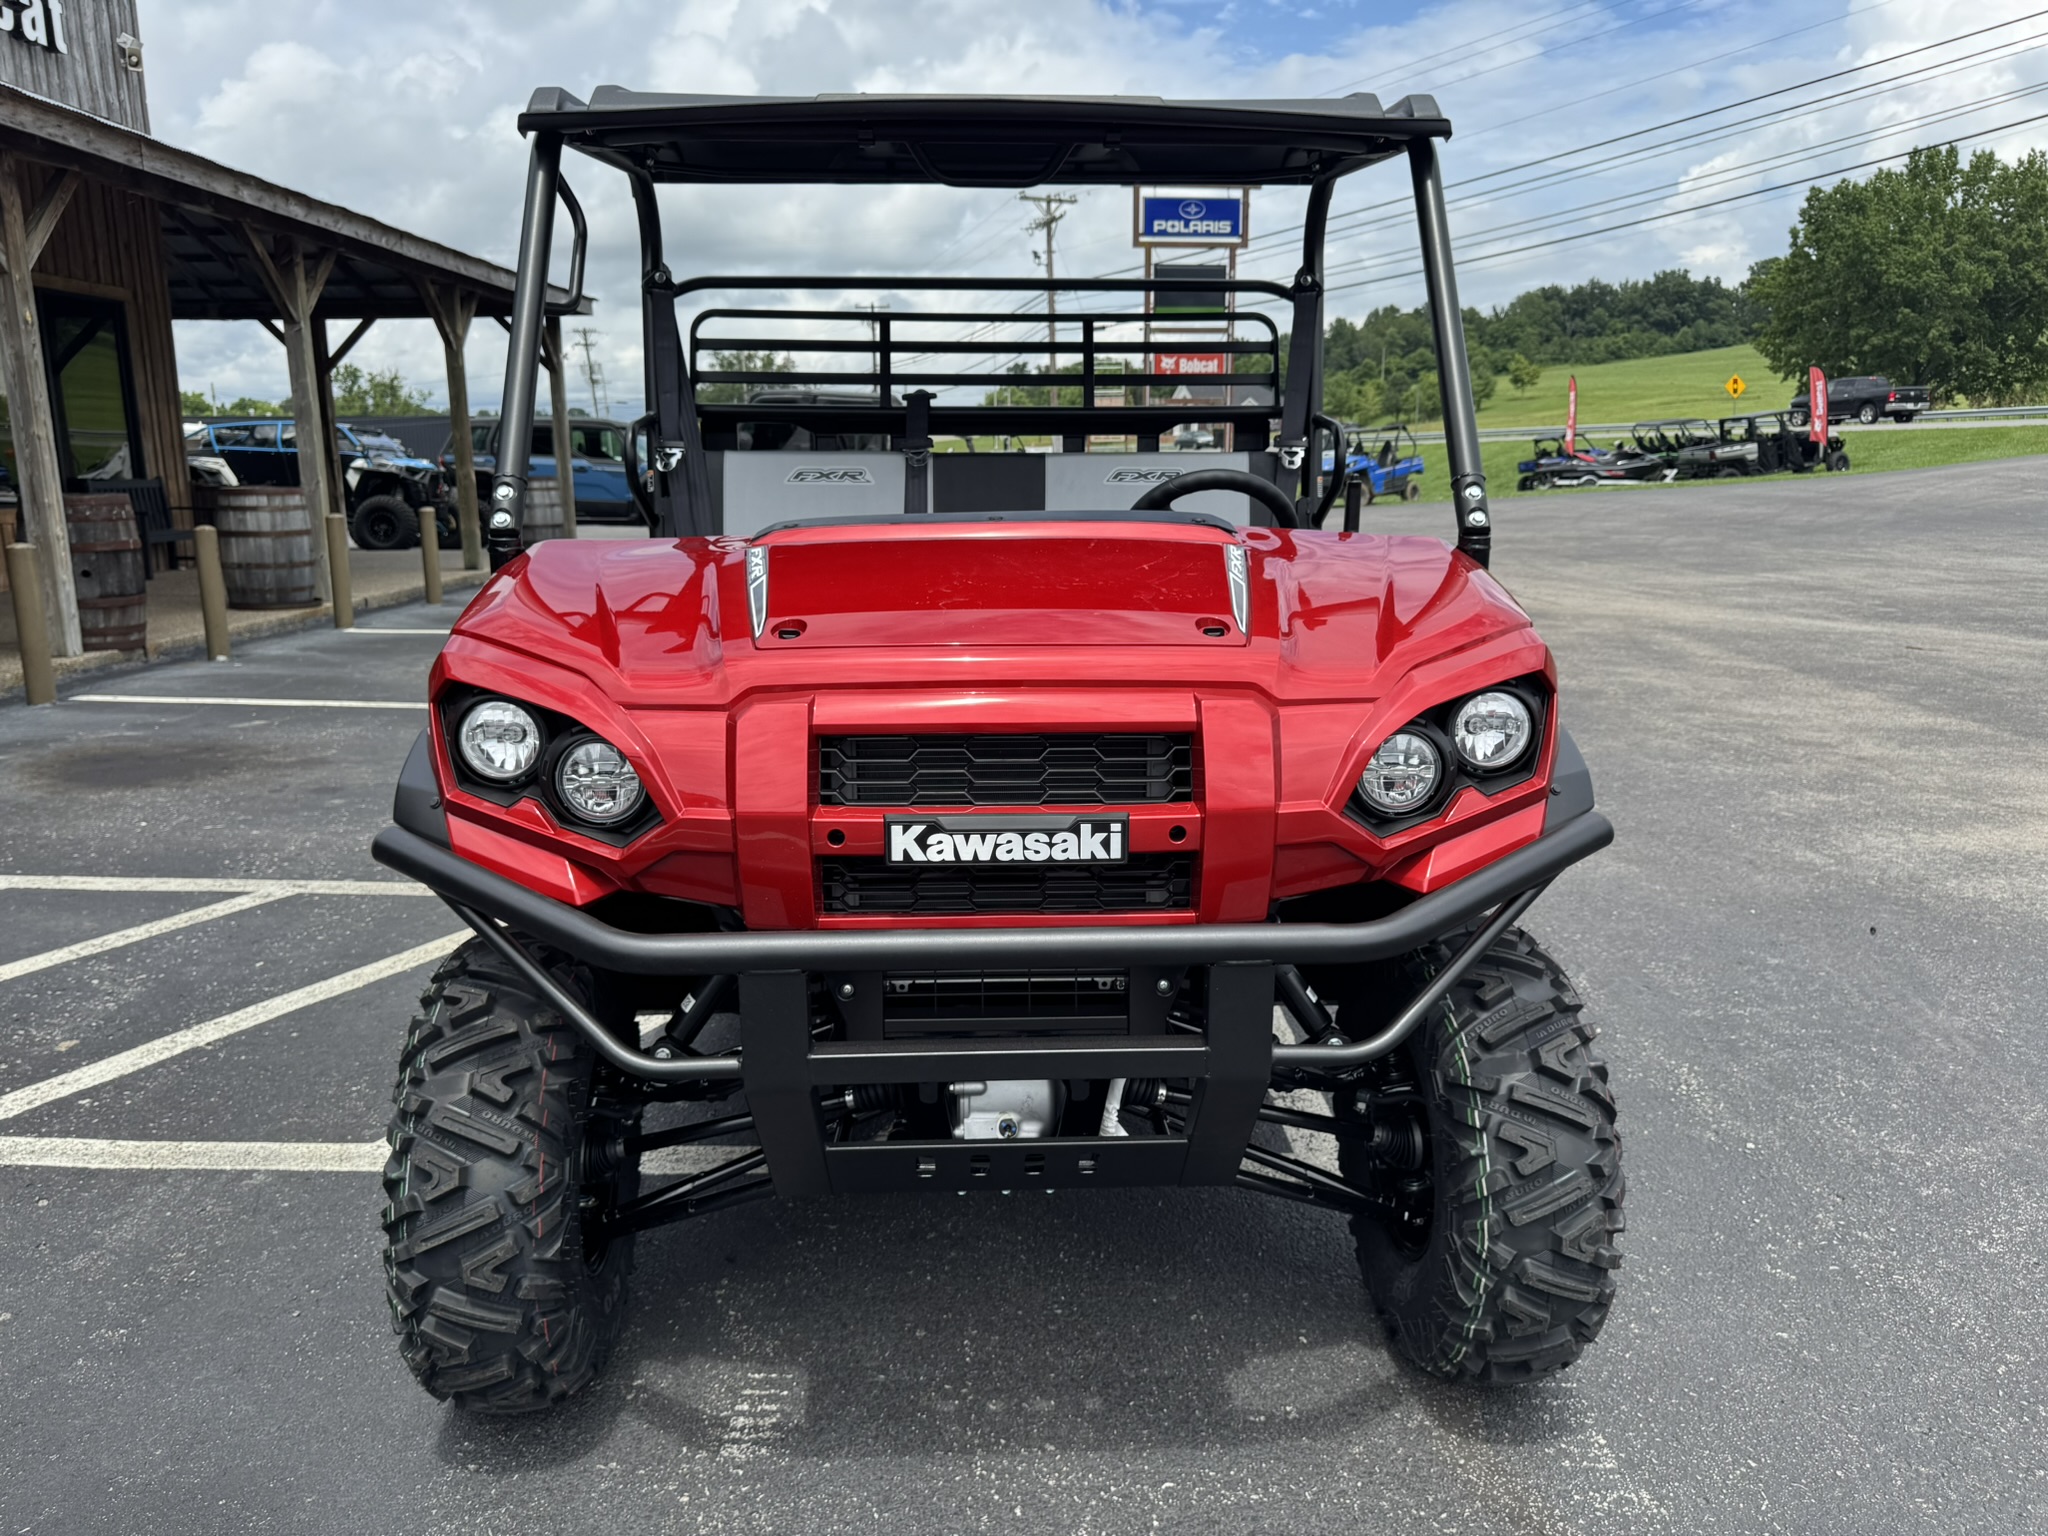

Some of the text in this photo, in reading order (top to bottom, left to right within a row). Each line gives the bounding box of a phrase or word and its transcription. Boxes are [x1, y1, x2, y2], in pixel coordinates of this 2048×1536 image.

[1153, 220, 1232, 234] POLARIS
[1179, 357, 1218, 374] Bobcat
[788, 469, 870, 482] FXR
[751, 547, 764, 581] FXR
[1230, 544, 1243, 578] FXR
[890, 823, 1122, 862] Kawasaki
